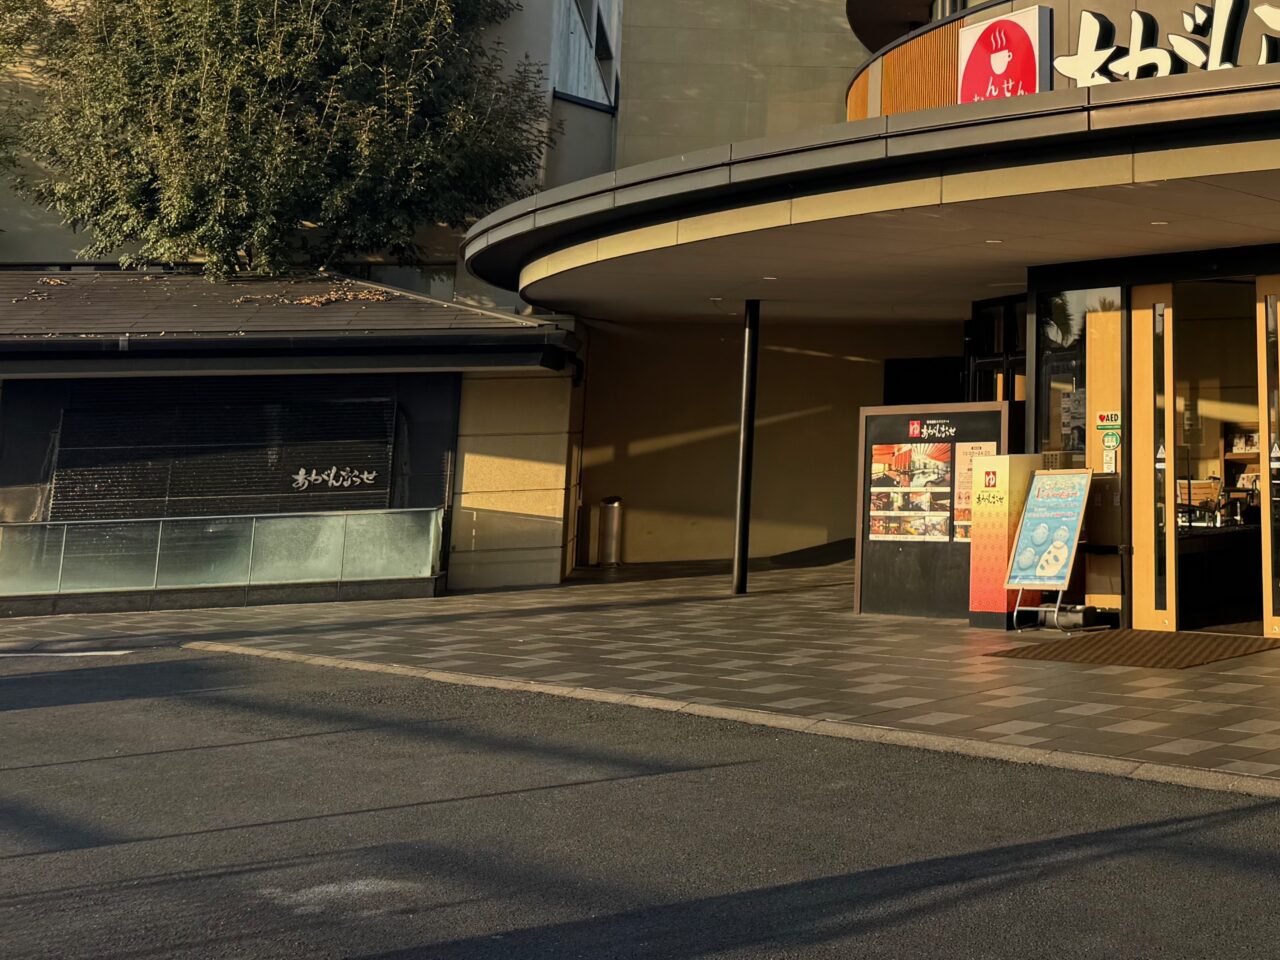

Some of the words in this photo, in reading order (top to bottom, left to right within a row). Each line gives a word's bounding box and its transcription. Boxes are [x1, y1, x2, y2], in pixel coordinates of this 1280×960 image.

[1105, 413, 1119, 422] AED
[292, 466, 378, 490] あがんなっせ
[985, 472, 996, 487] ゆ
